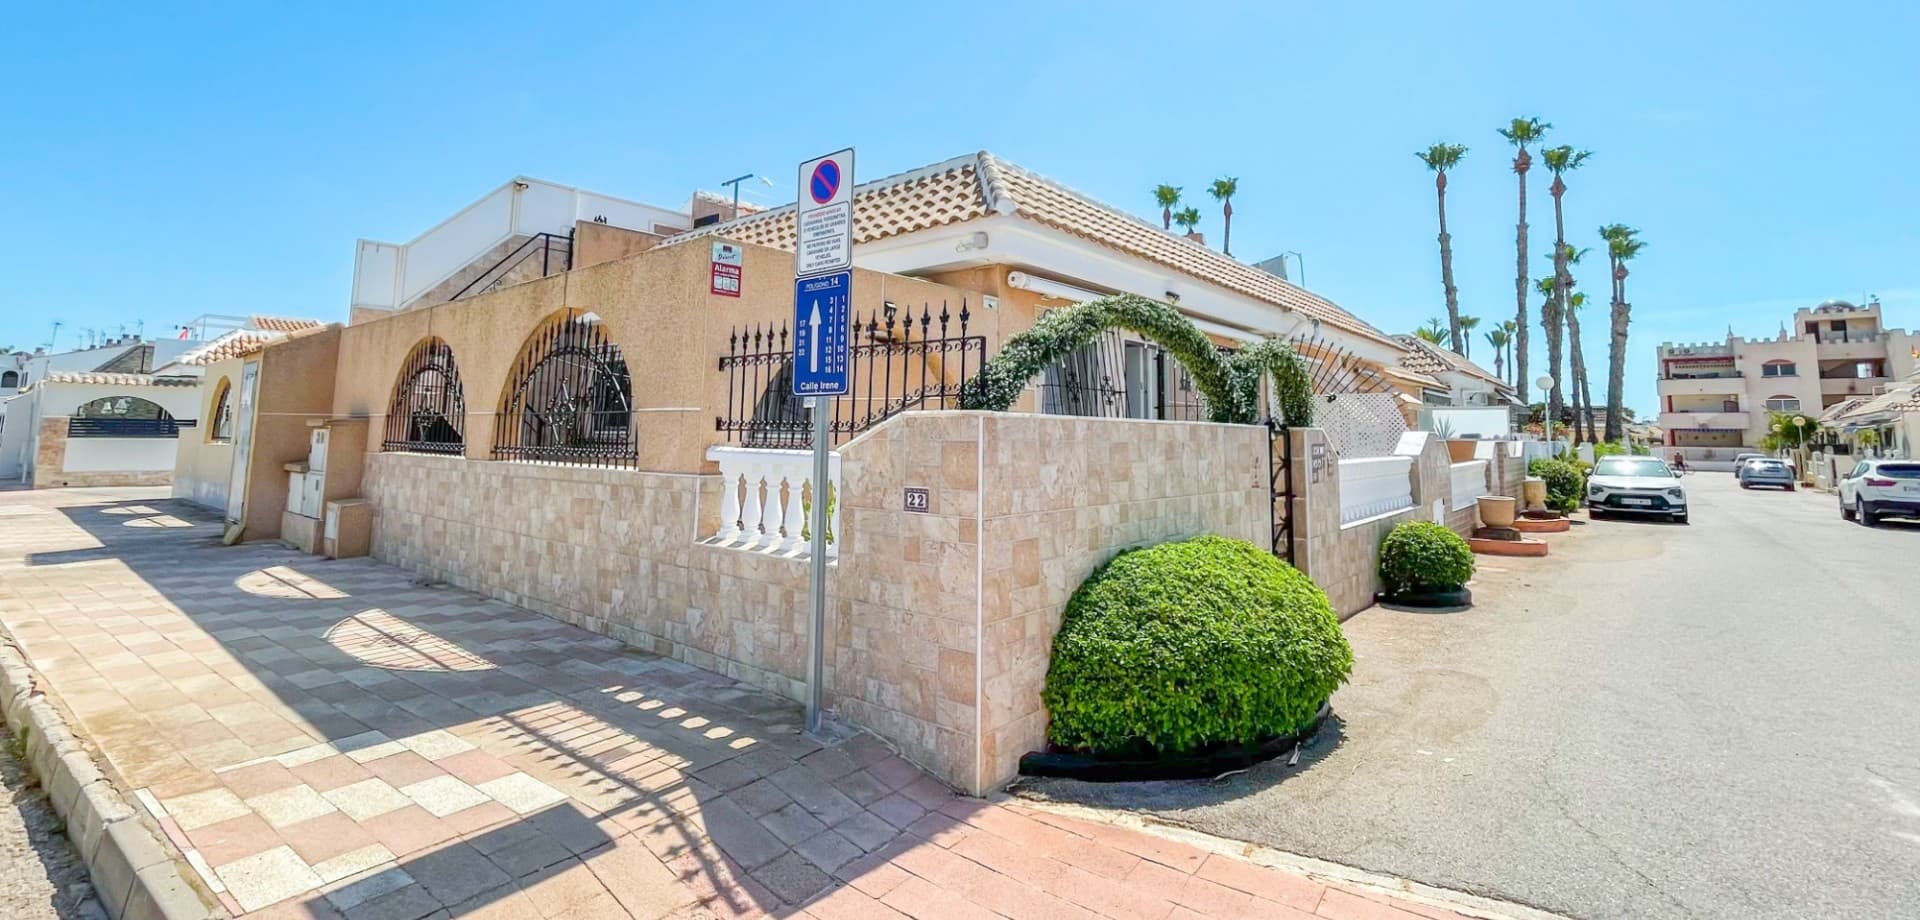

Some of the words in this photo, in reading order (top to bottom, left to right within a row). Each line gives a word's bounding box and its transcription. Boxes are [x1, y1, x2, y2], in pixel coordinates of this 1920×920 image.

[714, 263, 739, 275] Alarma
[831, 276, 839, 286] 14
[829, 306, 833, 314] 4
[841, 305, 845, 313] 2
[840, 325, 845, 333] 6
[840, 335, 844, 343] 9
[825, 346, 832, 354] 12
[837, 345, 844, 353] 10
[837, 355, 844, 363] 13
[836, 365, 843, 373] 14
[800, 381, 819, 391] Calle
[820, 380, 839, 390] Irene
[909, 493, 924, 507] 22
